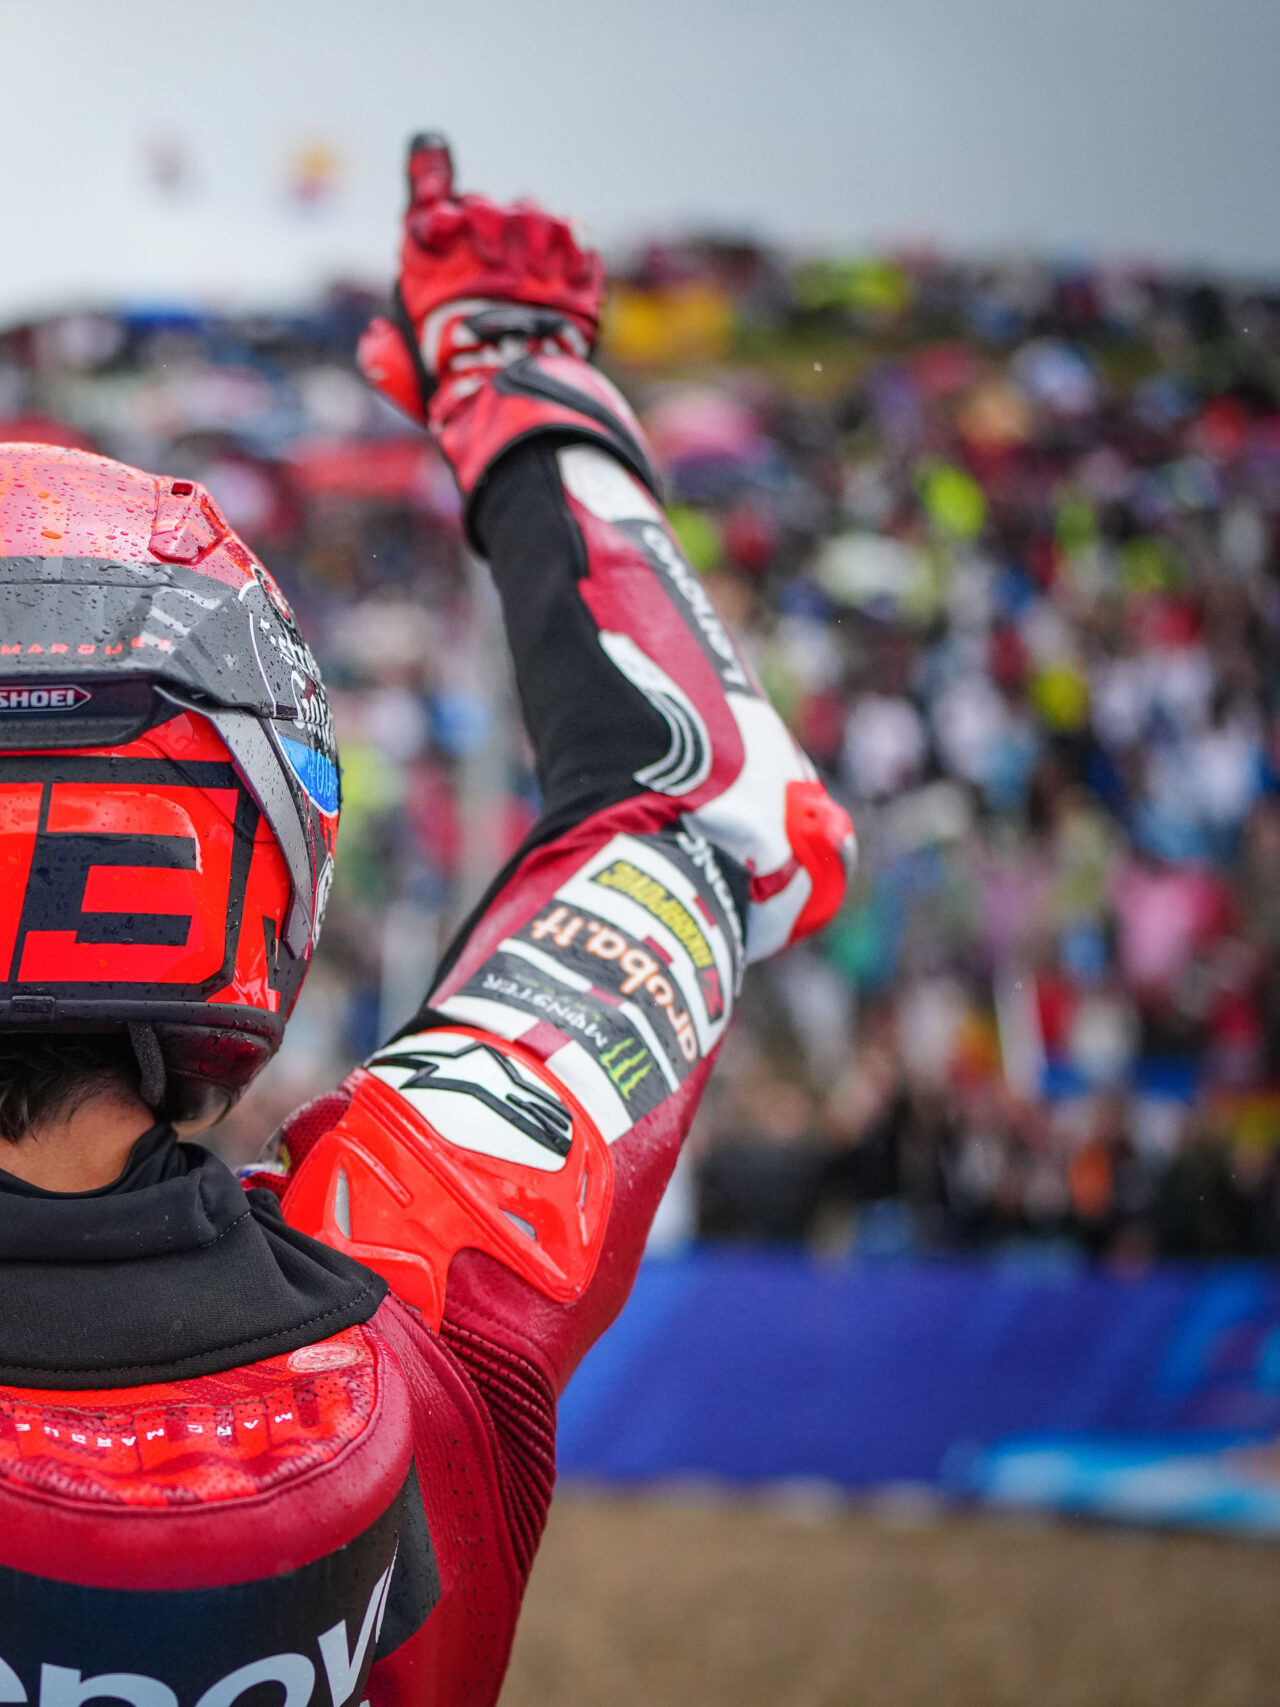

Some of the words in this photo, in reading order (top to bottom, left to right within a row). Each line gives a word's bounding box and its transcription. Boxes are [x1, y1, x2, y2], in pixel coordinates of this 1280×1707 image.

[482, 972, 608, 1050] MONSTER
[529, 906, 699, 1063] aruba.it
[186, 1411, 295, 1436] MARC
